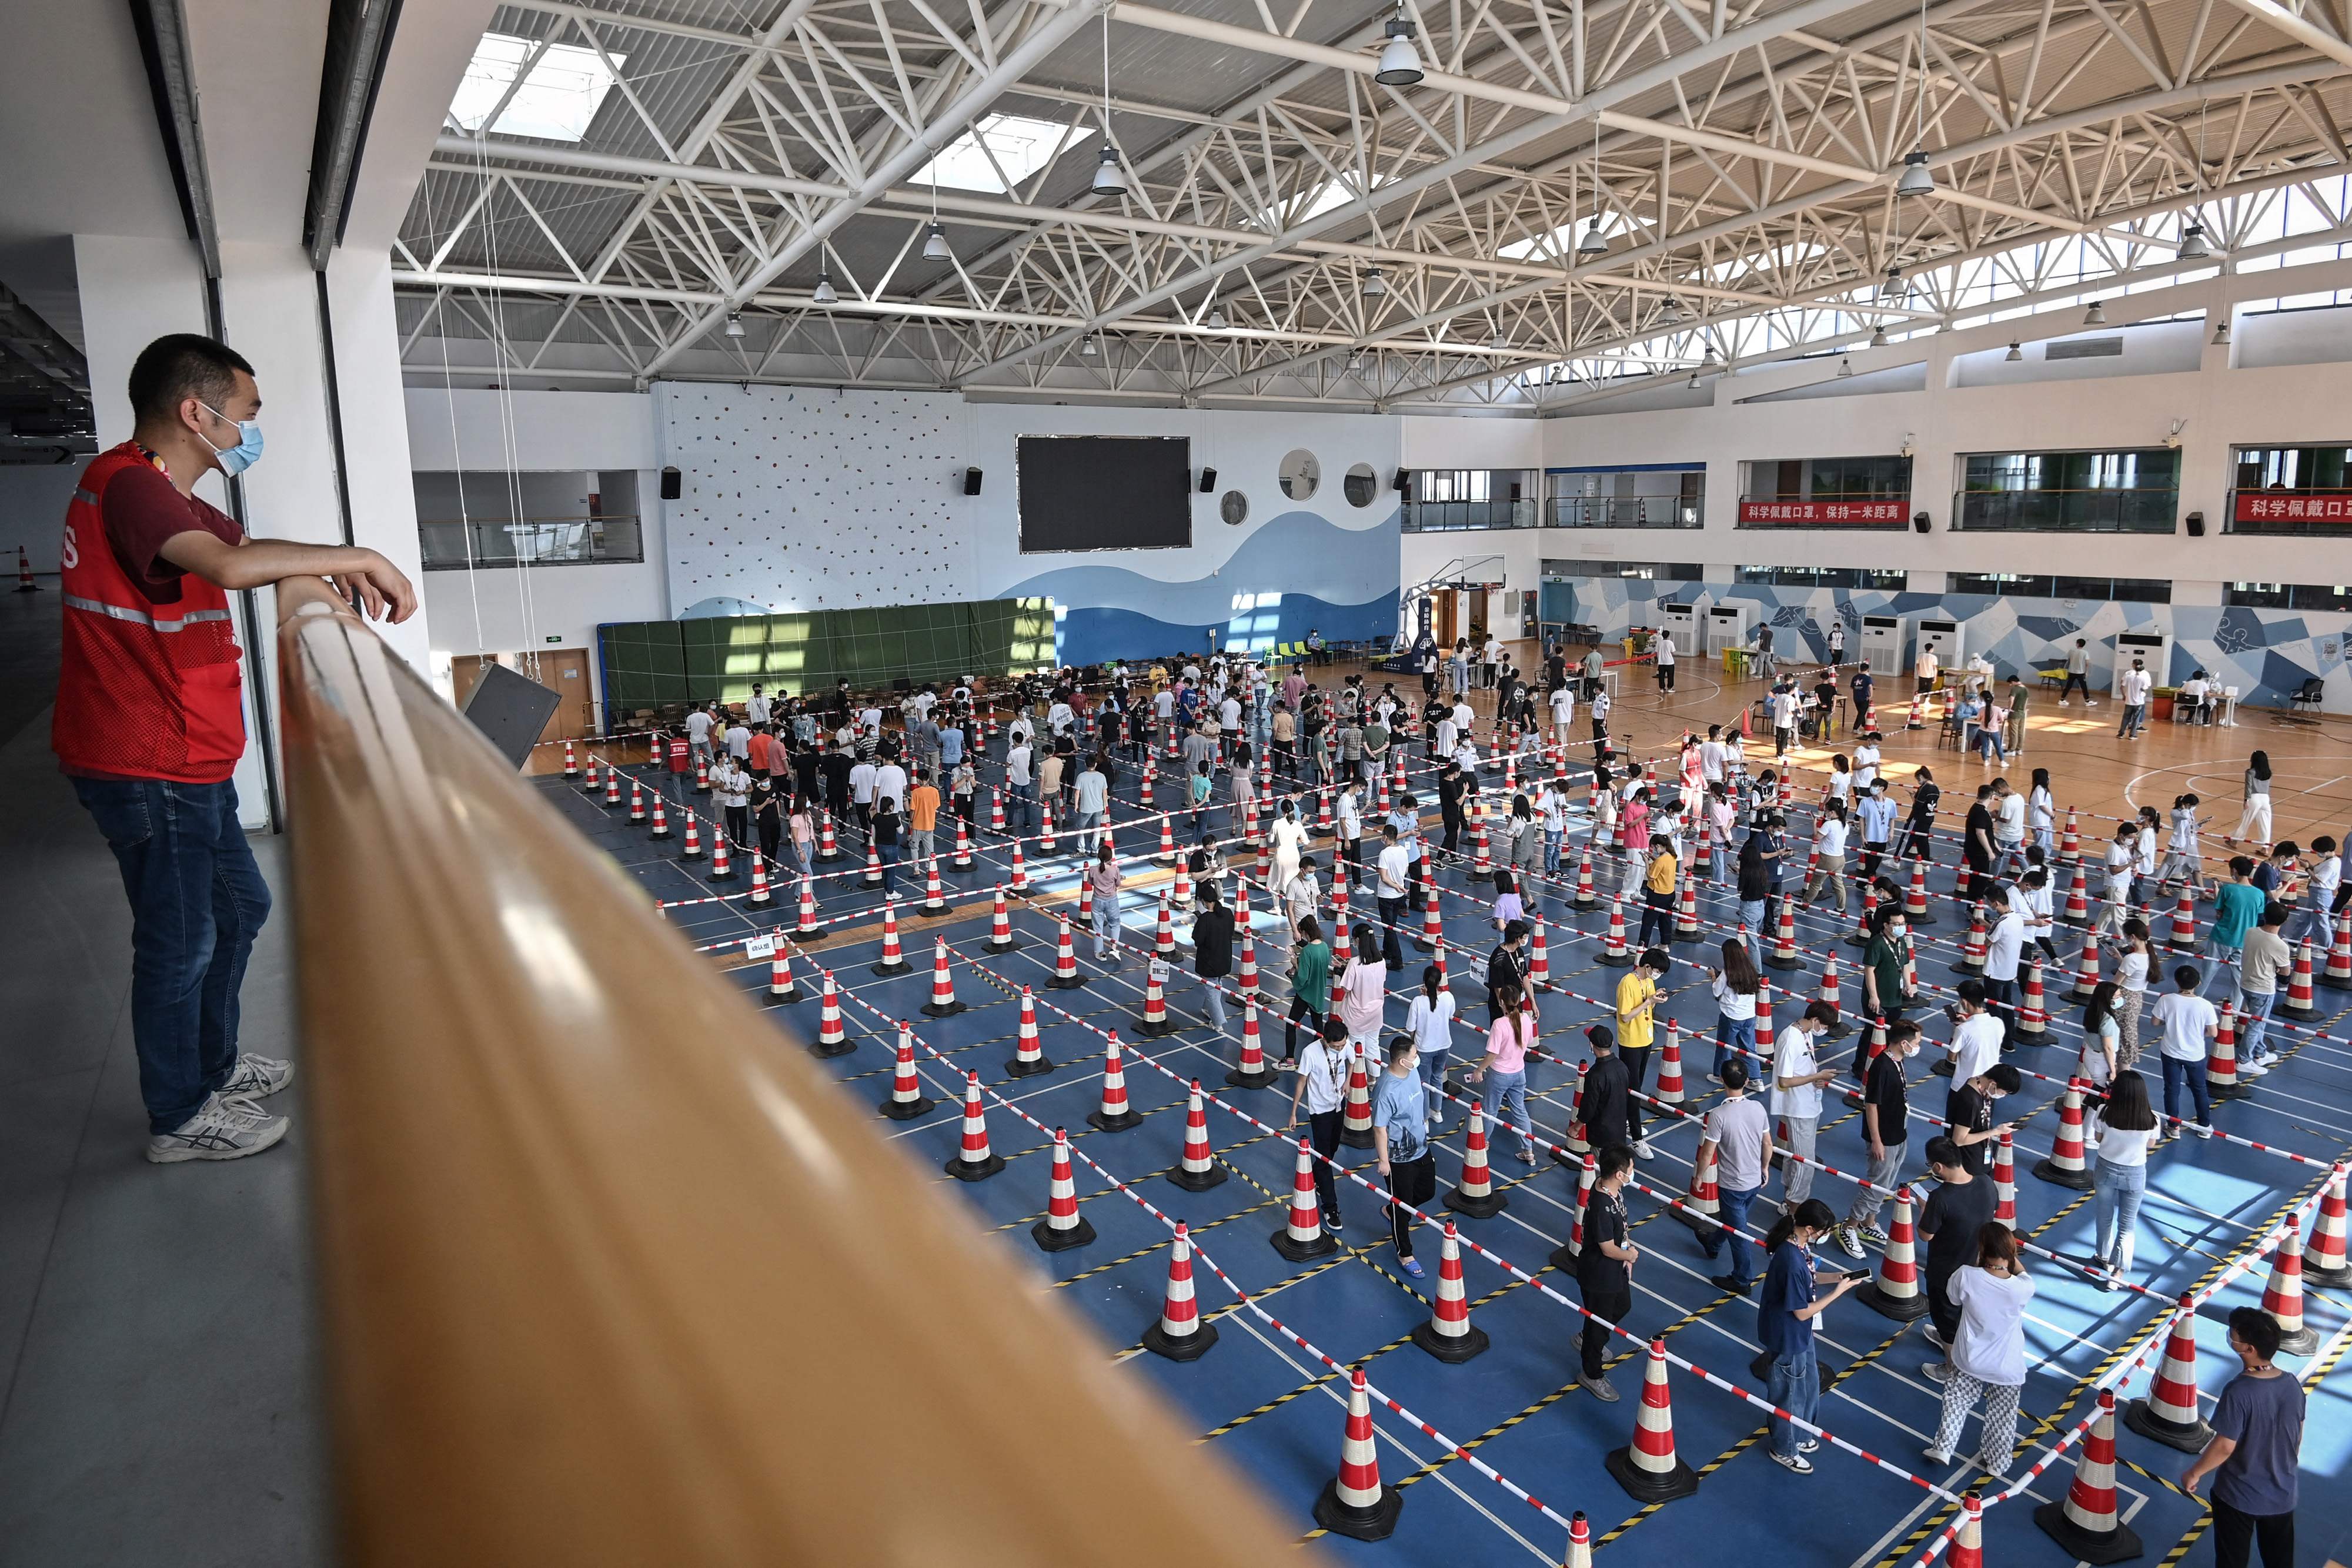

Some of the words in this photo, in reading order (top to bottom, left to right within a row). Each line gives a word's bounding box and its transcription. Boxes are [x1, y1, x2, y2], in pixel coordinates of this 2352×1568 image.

[1748, 504, 1899, 519] 科学佩戴口罩，保持一米距离
